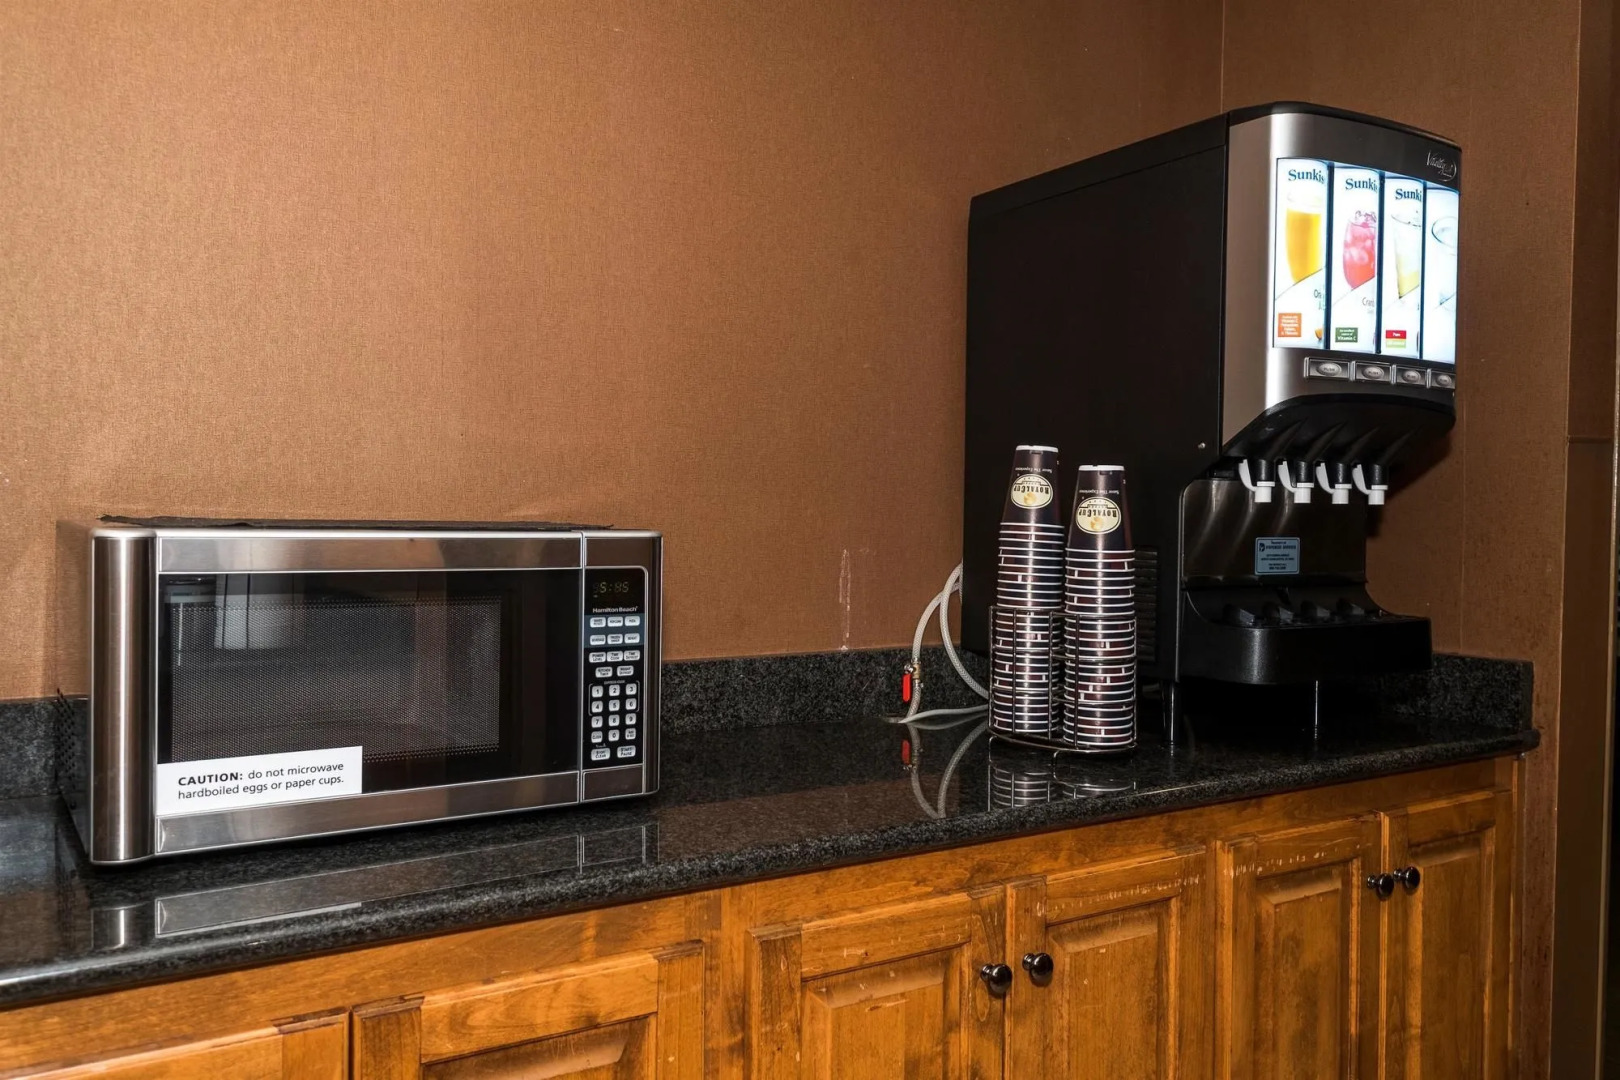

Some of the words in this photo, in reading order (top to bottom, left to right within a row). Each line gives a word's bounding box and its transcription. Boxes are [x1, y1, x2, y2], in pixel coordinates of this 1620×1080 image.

[178, 772, 243, 786] CAUTION:
[248, 770, 262, 780] do
[265, 768, 284, 778] not
[287, 762, 344, 776] microwave
[178, 785, 239, 800] hardboiled
[242, 782, 268, 794] eggs
[270, 781, 282, 790] or
[285, 778, 315, 791] paper
[318, 774, 344, 786] cups.
